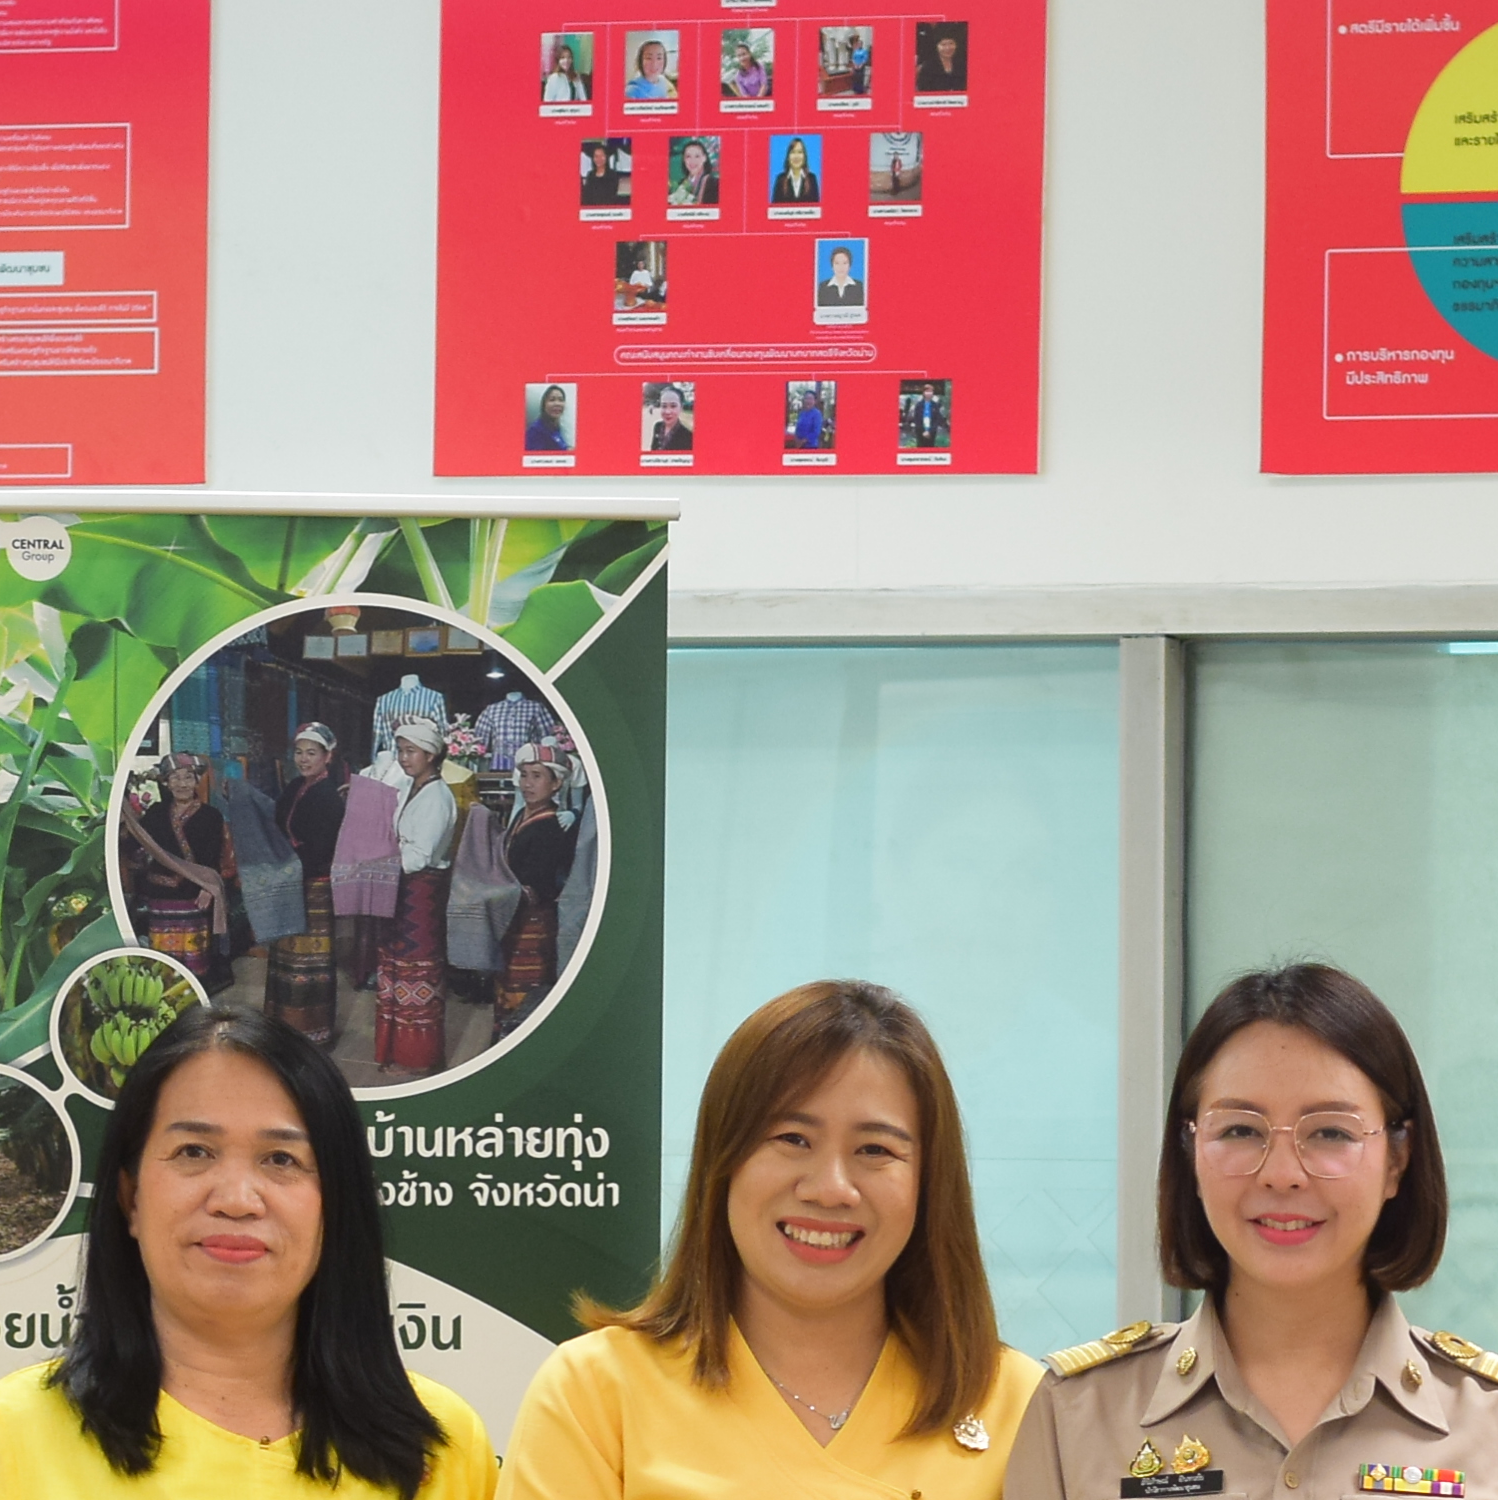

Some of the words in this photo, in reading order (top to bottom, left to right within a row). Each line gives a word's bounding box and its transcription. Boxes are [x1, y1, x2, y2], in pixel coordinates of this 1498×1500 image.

[1346, 348, 1455, 364] การบริหารกองทุน
[1345, 371, 1429, 386] มีประสิทธิภาพ
[11, 538, 65, 551] CENTRAL
[21, 550, 55, 564] Group
[367, 1110, 610, 1172] บ้านหล่ายทุ่ง
[391, 1303, 463, 1351] งิน
